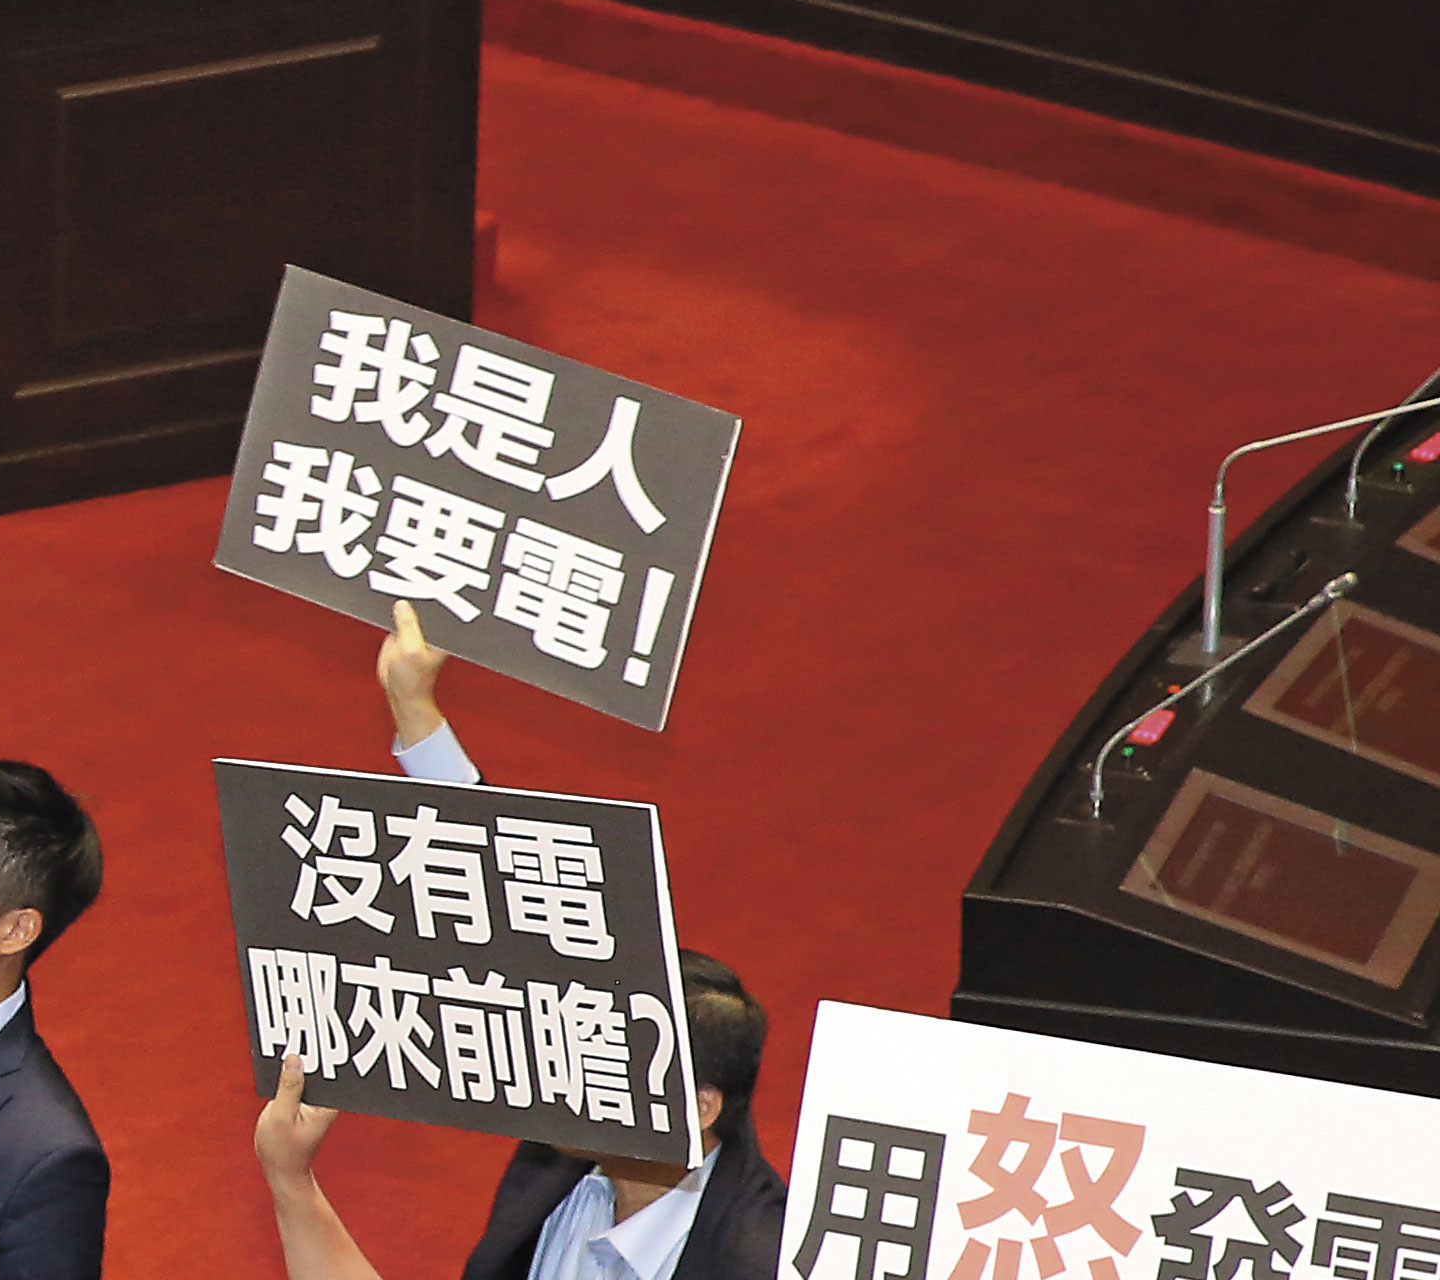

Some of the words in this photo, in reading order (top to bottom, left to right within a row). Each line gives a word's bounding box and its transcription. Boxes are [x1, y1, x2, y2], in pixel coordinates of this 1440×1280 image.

[311, 309, 667, 536] 我是人
[253, 441, 675, 687] 我要電!
[280, 793, 616, 962] 沒有電
[246, 945, 676, 1133] 哪來前瞻?
